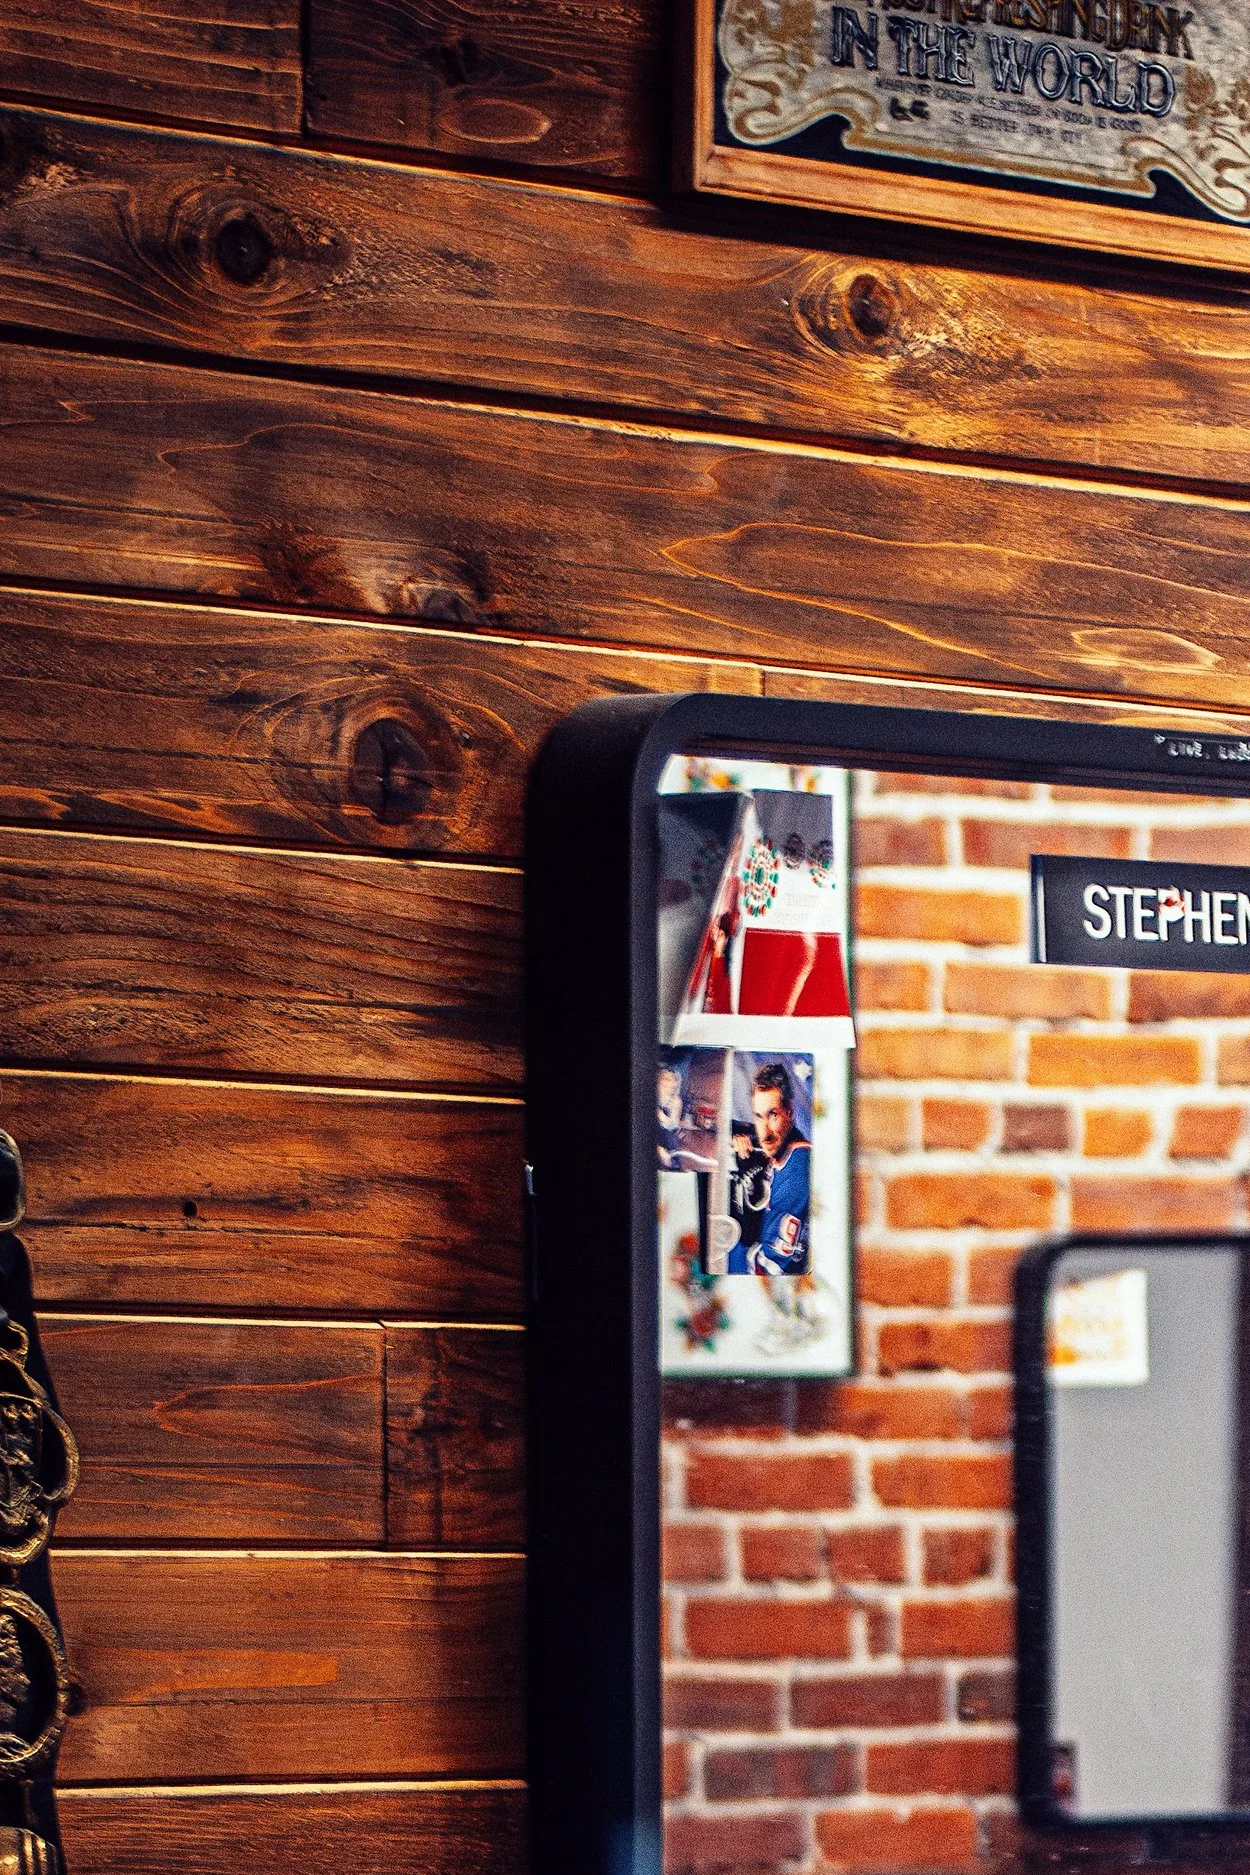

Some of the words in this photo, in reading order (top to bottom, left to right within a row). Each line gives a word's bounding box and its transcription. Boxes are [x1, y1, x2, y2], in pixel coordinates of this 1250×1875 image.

[831, 5, 879, 70] IN
[887, 14, 976, 88] THE
[986, 32, 1177, 118] WORLD
